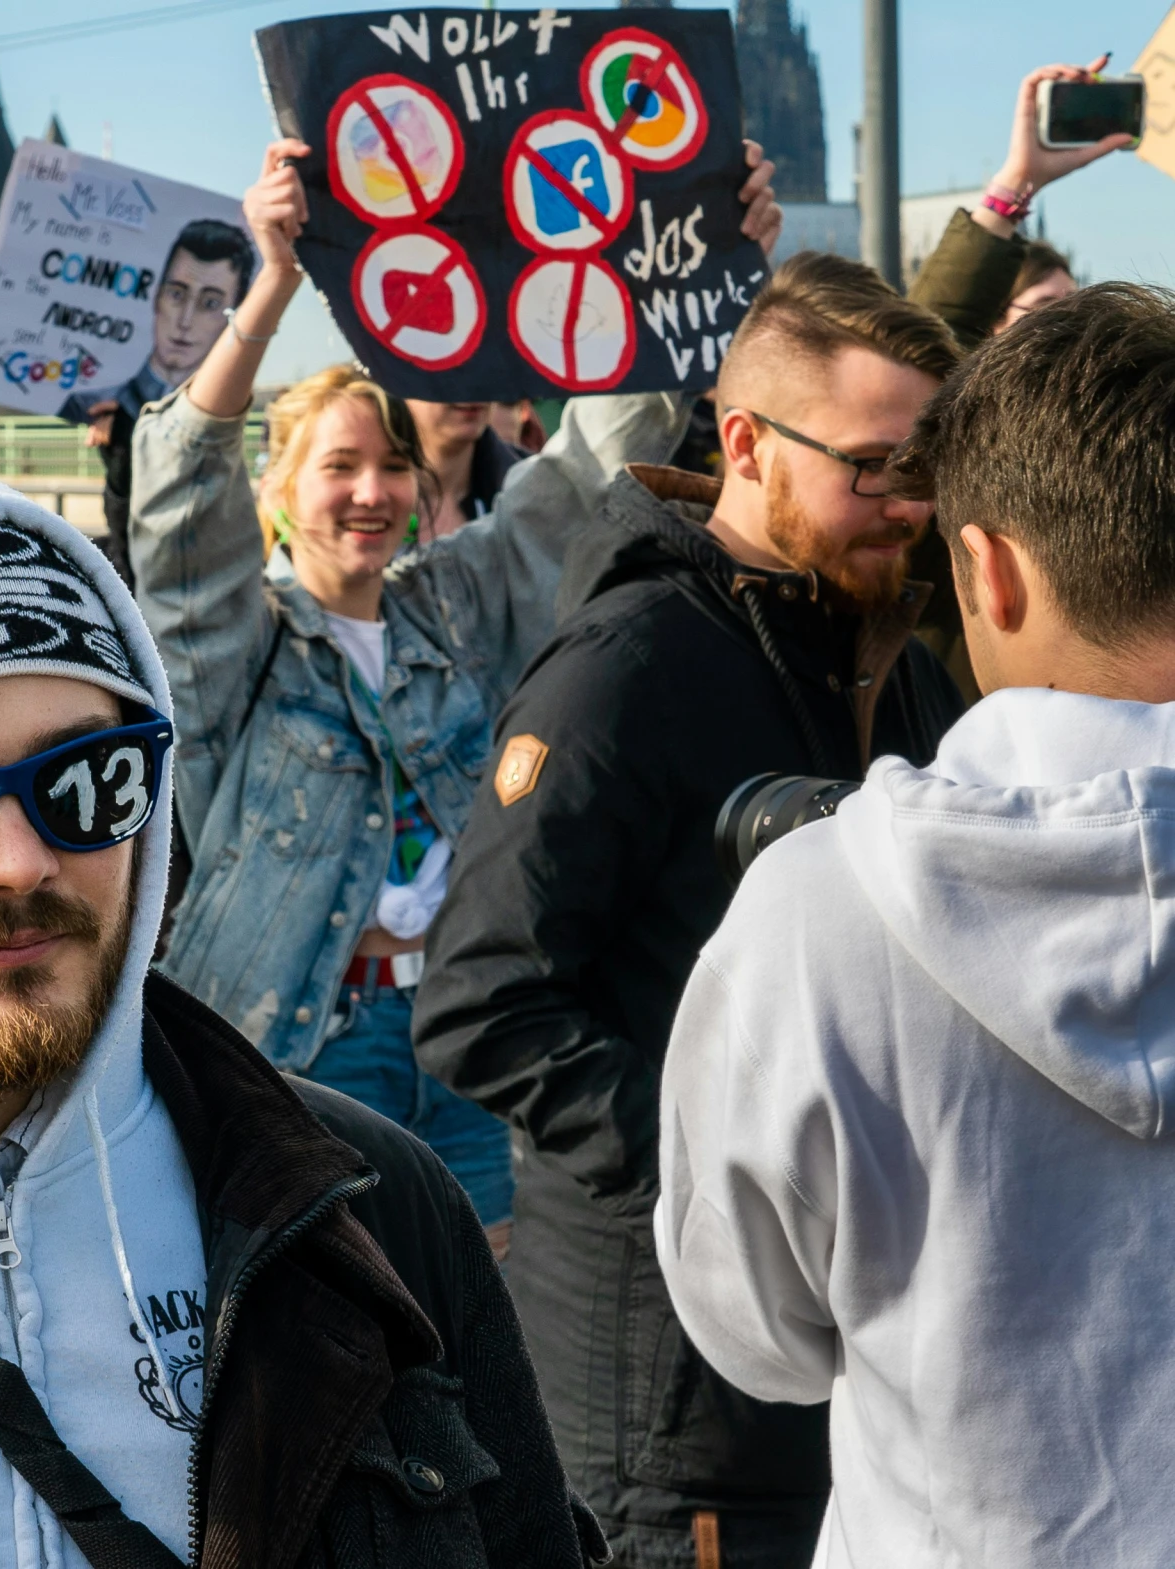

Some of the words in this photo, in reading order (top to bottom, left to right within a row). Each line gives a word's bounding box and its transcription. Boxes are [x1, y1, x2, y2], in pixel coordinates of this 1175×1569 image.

[10, 199, 41, 234] My
[44, 217, 93, 242] name
[623, 199, 708, 282] das
[40, 248, 155, 301] CONNOR
[41, 301, 134, 344] ANDROID
[4, 351, 99, 390] Google
[48, 747, 149, 836] 13
